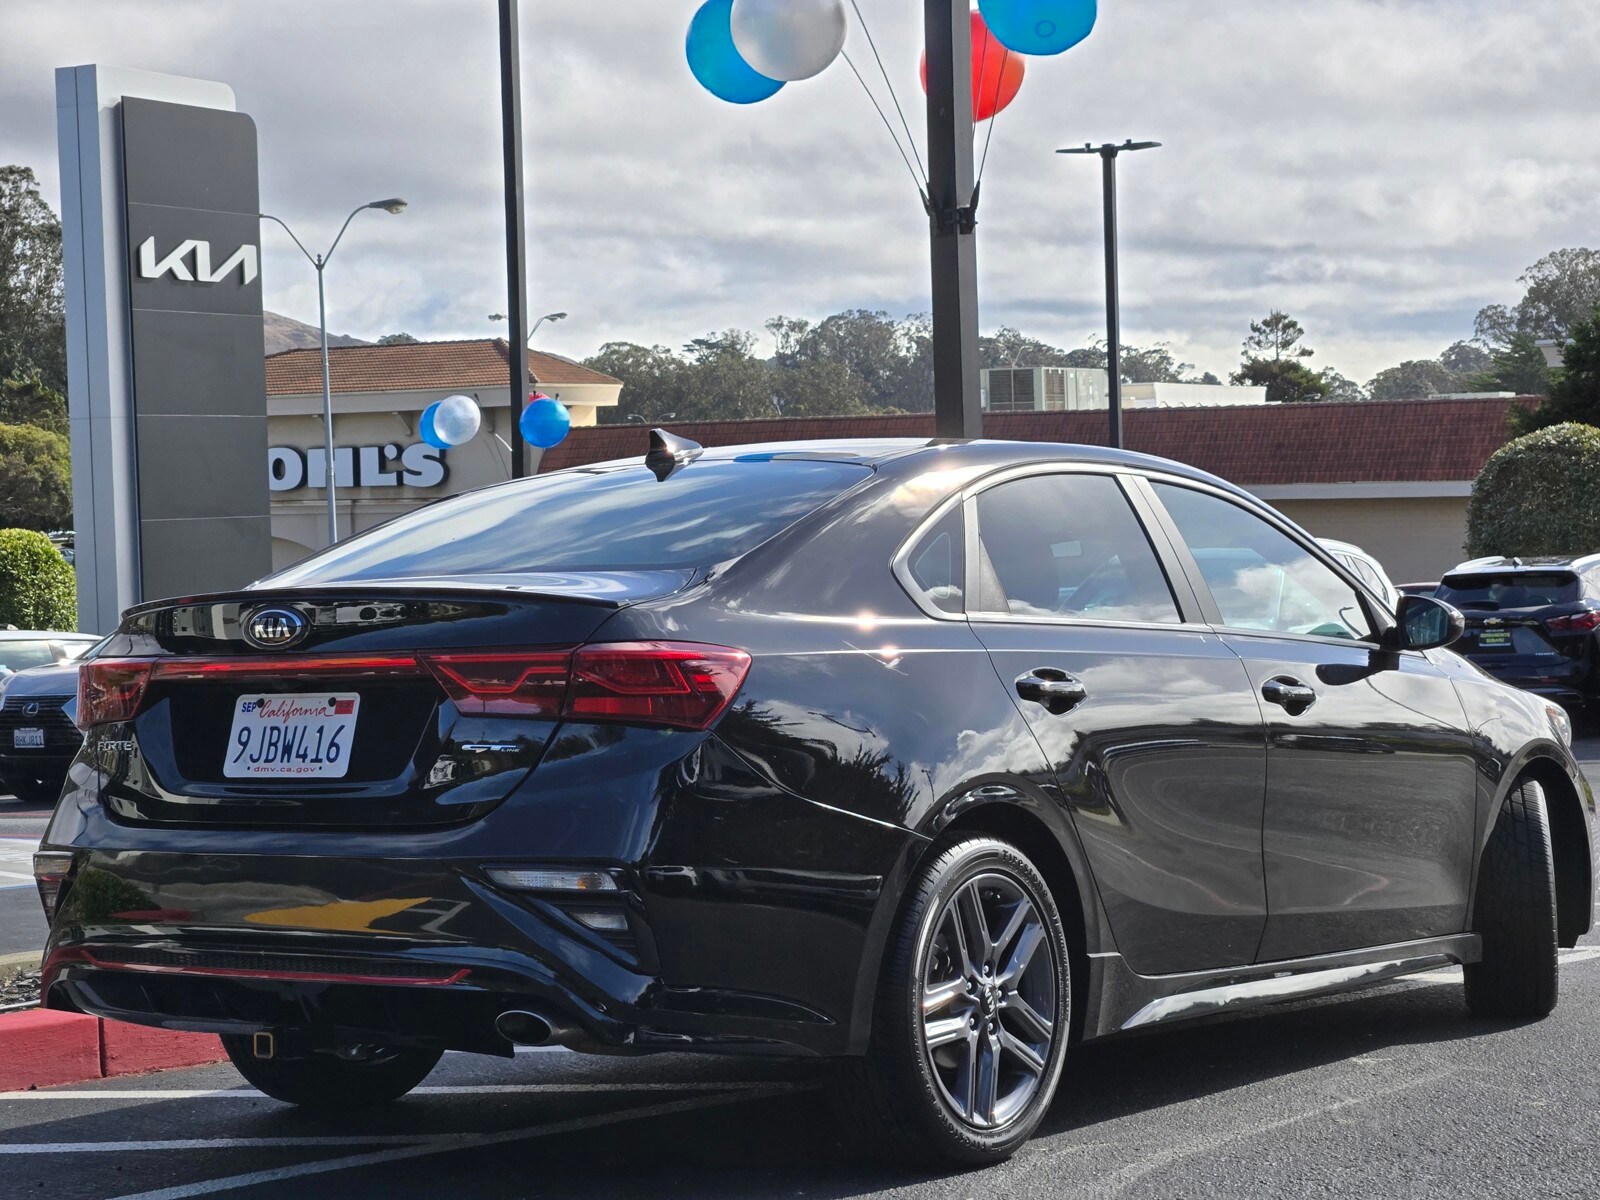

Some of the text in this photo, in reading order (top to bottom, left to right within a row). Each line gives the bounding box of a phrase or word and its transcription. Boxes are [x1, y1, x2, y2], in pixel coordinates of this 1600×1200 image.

[140, 235, 258, 285] KIA
[267, 443, 446, 491] OHL'S
[254, 617, 291, 638] KIA
[241, 701, 257, 713] SEP
[259, 699, 335, 724] California
[97, 740, 133, 751] FORTE
[232, 724, 346, 764] 9JBW416
[253, 765, 317, 773] dmv.ca.gov
[1002, 849, 1049, 900] Firestone
